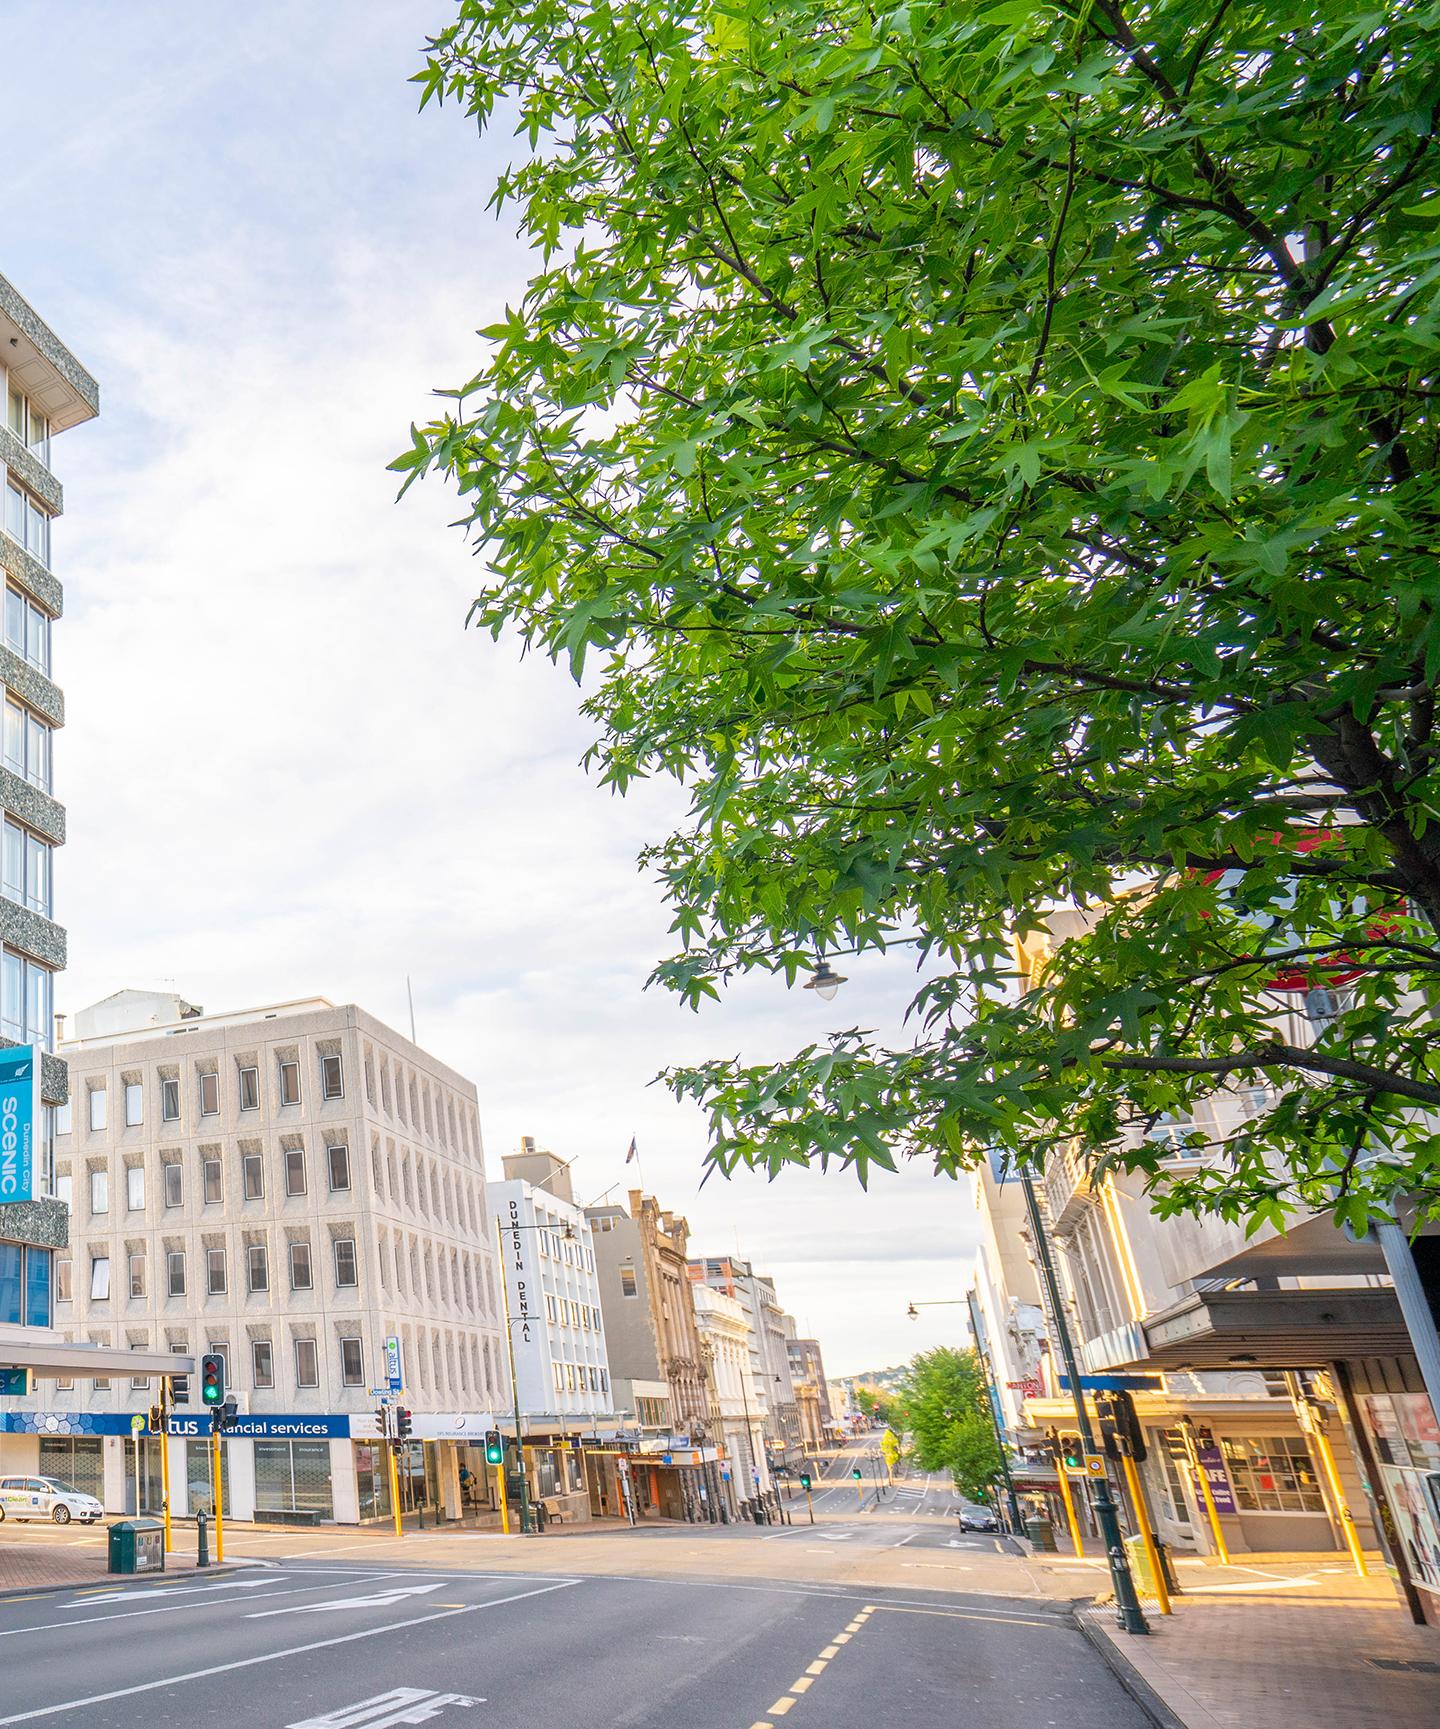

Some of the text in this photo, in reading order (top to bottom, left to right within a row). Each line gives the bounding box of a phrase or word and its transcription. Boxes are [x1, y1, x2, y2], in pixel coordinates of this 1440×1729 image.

[21, 1123, 31, 1192] Dunedin City
[509, 1200, 531, 1343] DUNEDIN DENTAL
[388, 1352, 397, 1374] altus
[149, 1419, 329, 1435] tus fancial services
